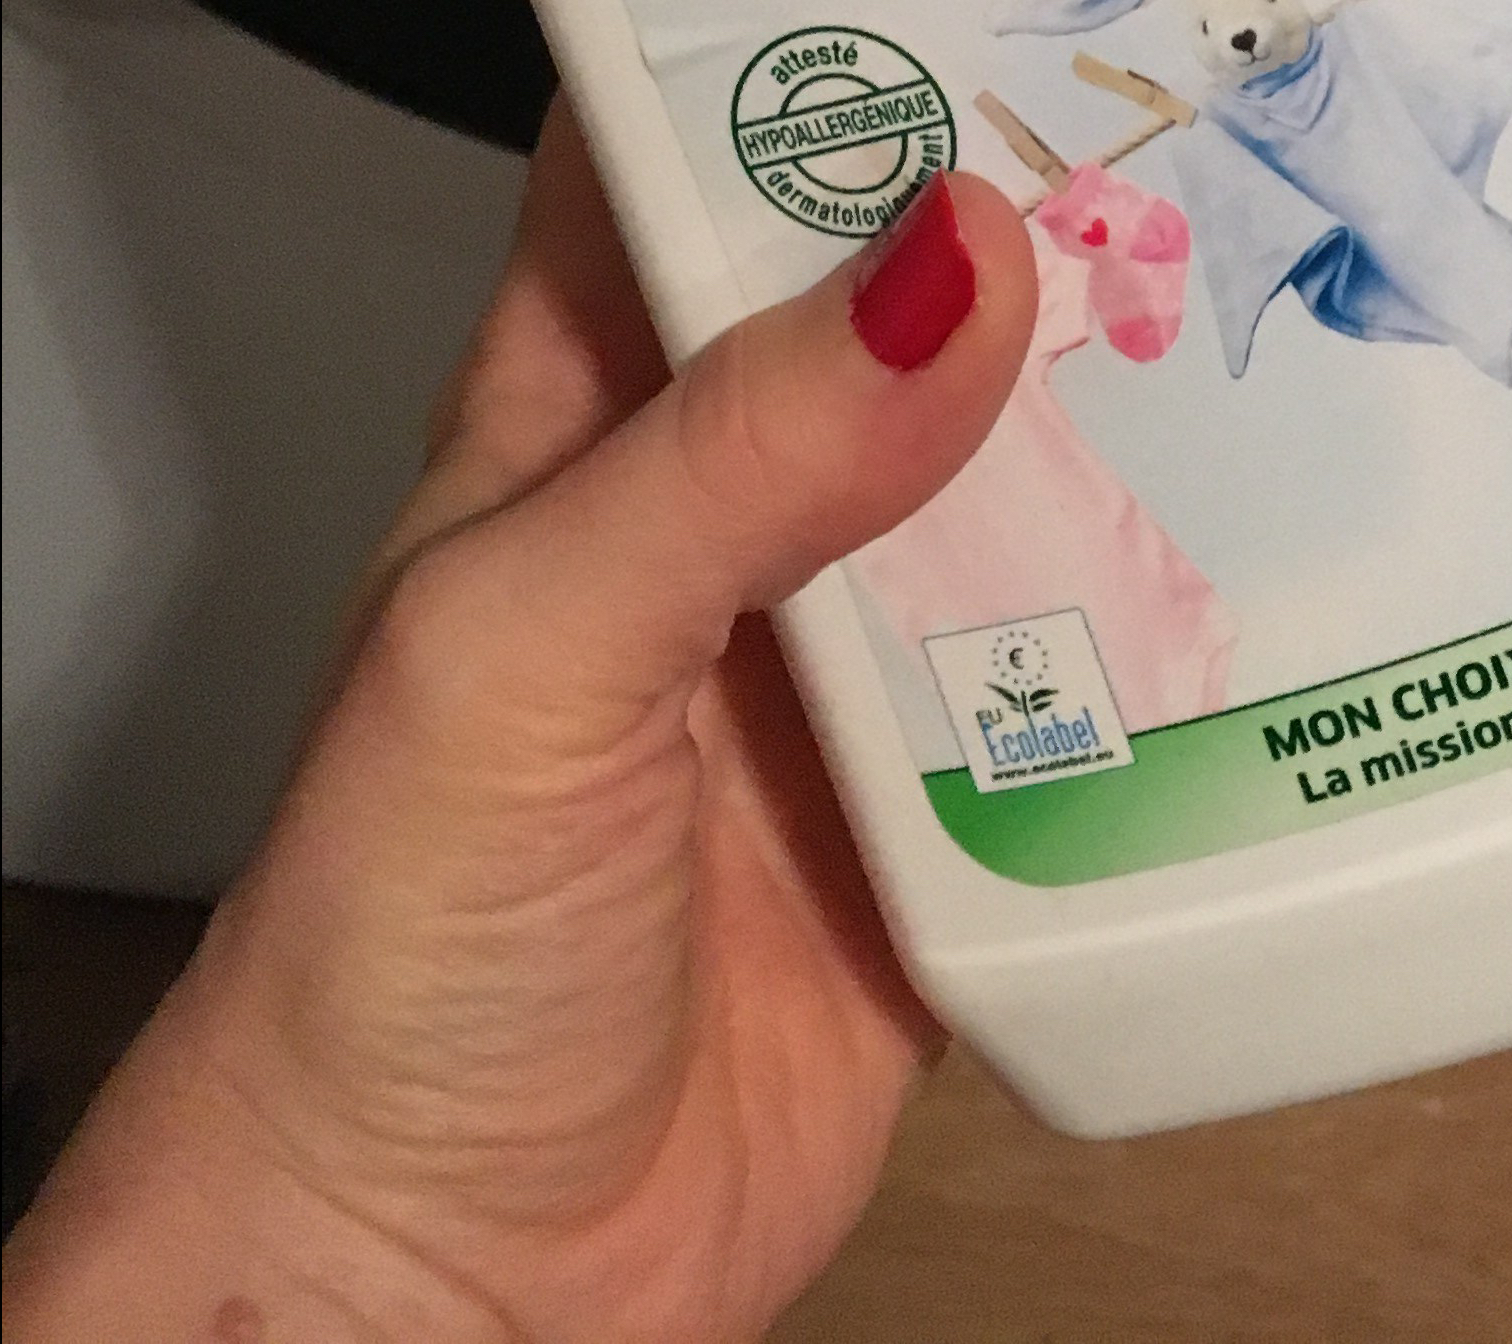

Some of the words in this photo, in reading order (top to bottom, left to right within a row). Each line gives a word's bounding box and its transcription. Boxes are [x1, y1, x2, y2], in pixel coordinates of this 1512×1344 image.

[770, 40, 858, 85] attesté
[982, 705, 1101, 767] Ecolabel
[1261, 696, 1383, 762] MON
[1296, 765, 1352, 804] La
